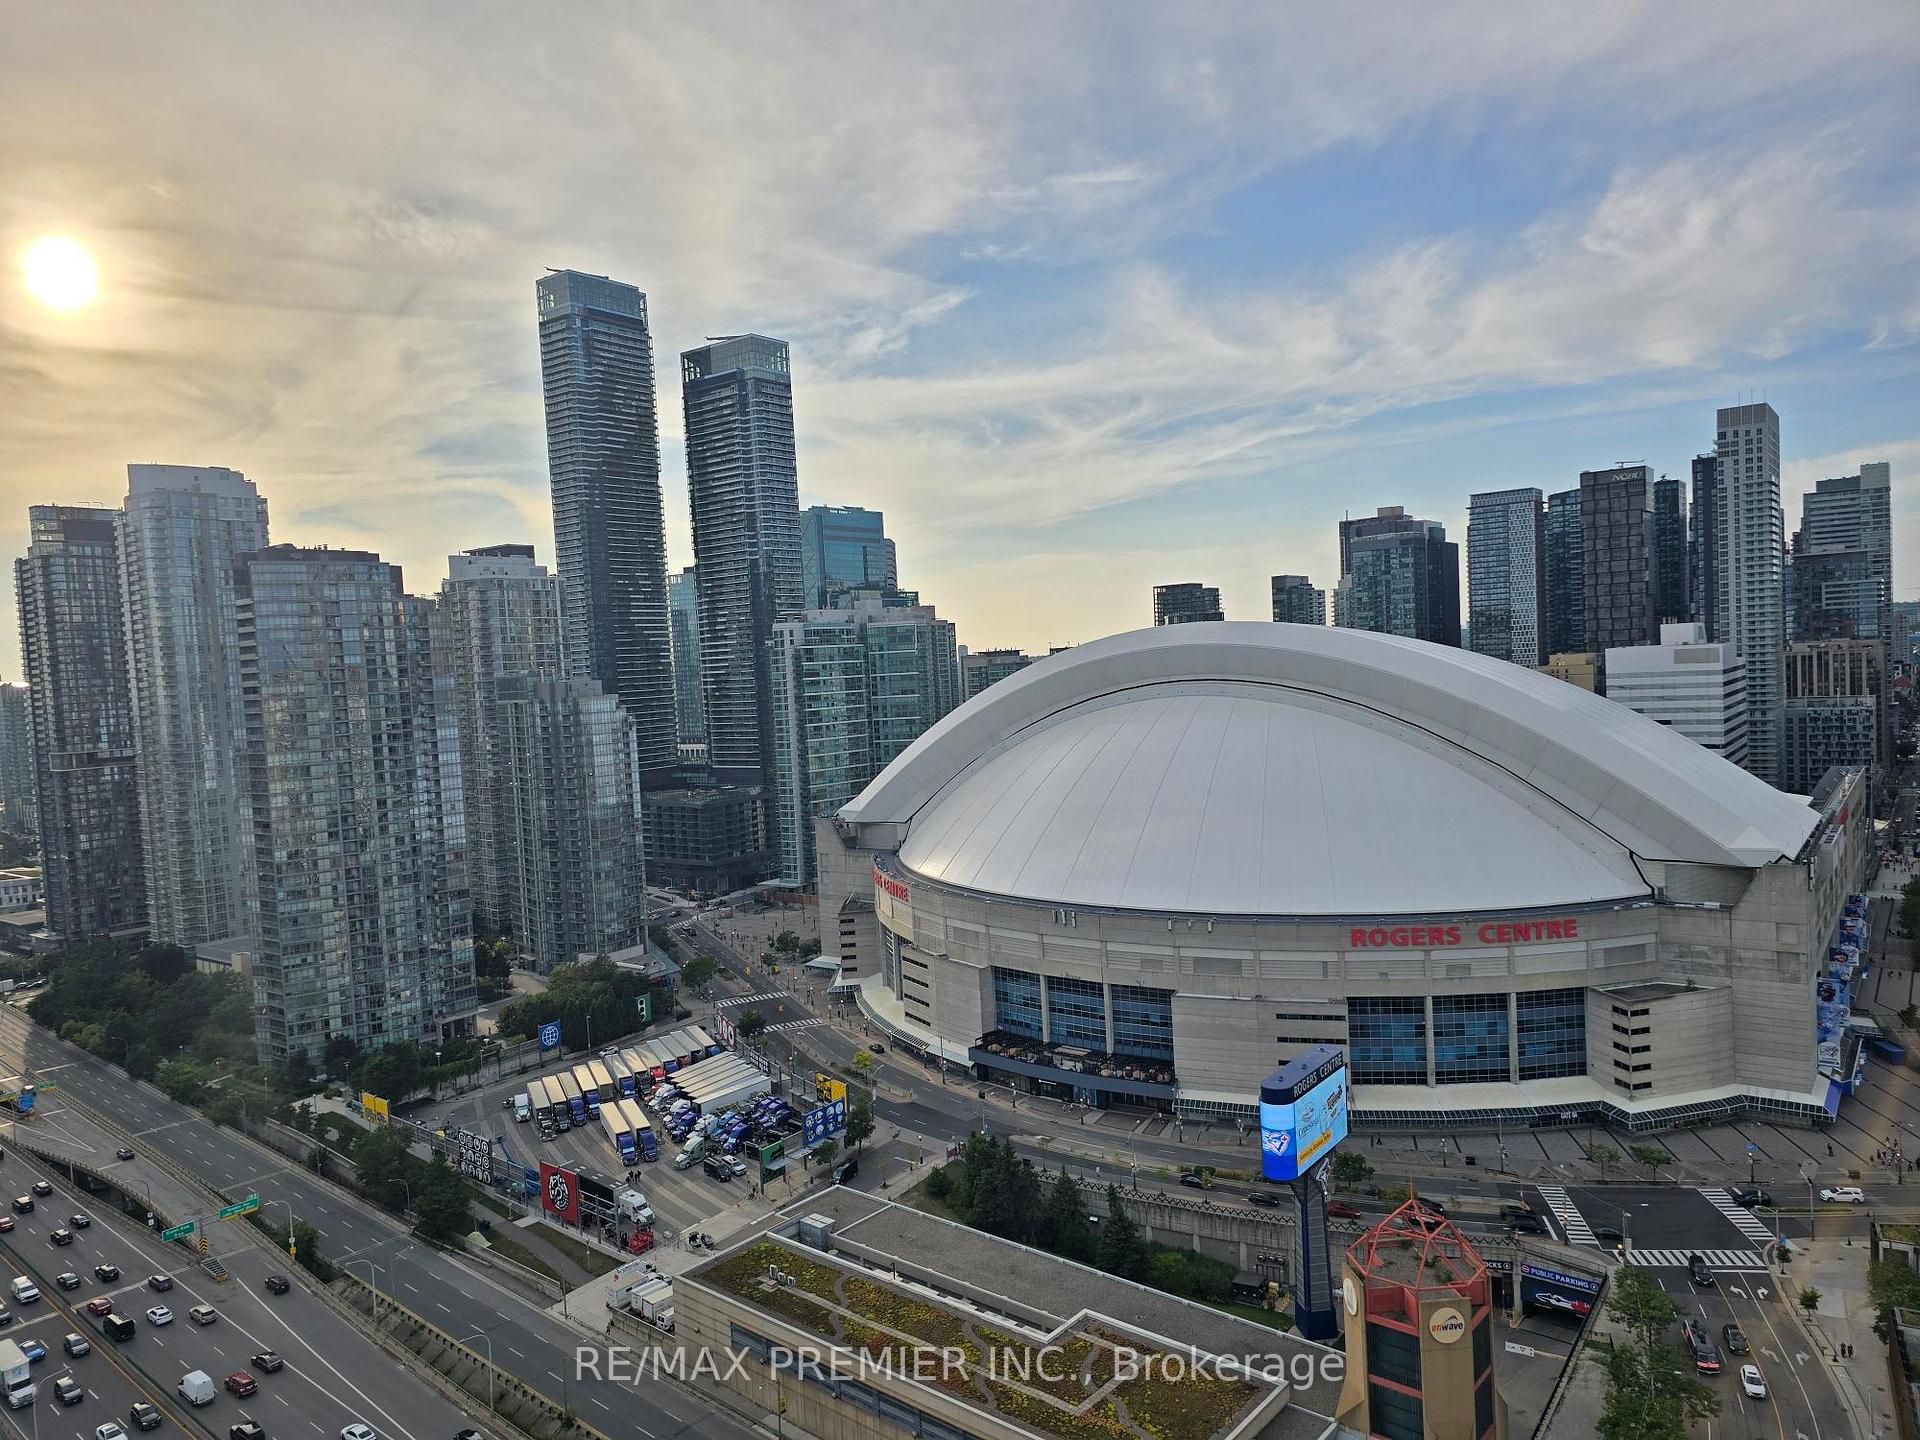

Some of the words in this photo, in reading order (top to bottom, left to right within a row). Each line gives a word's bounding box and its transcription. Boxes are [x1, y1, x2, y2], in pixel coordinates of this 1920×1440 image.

[1351, 926, 1462, 947] ROGERS
[1477, 919, 1578, 944] CENTRE
[1293, 1071, 1318, 1098] ROGERS
[1320, 1054, 1343, 1078] CENTRE
[1530, 1268, 1555, 1280] PUBLIC
[1555, 1274, 1589, 1288] PARKING
[1431, 1322, 1464, 1332] enwave
